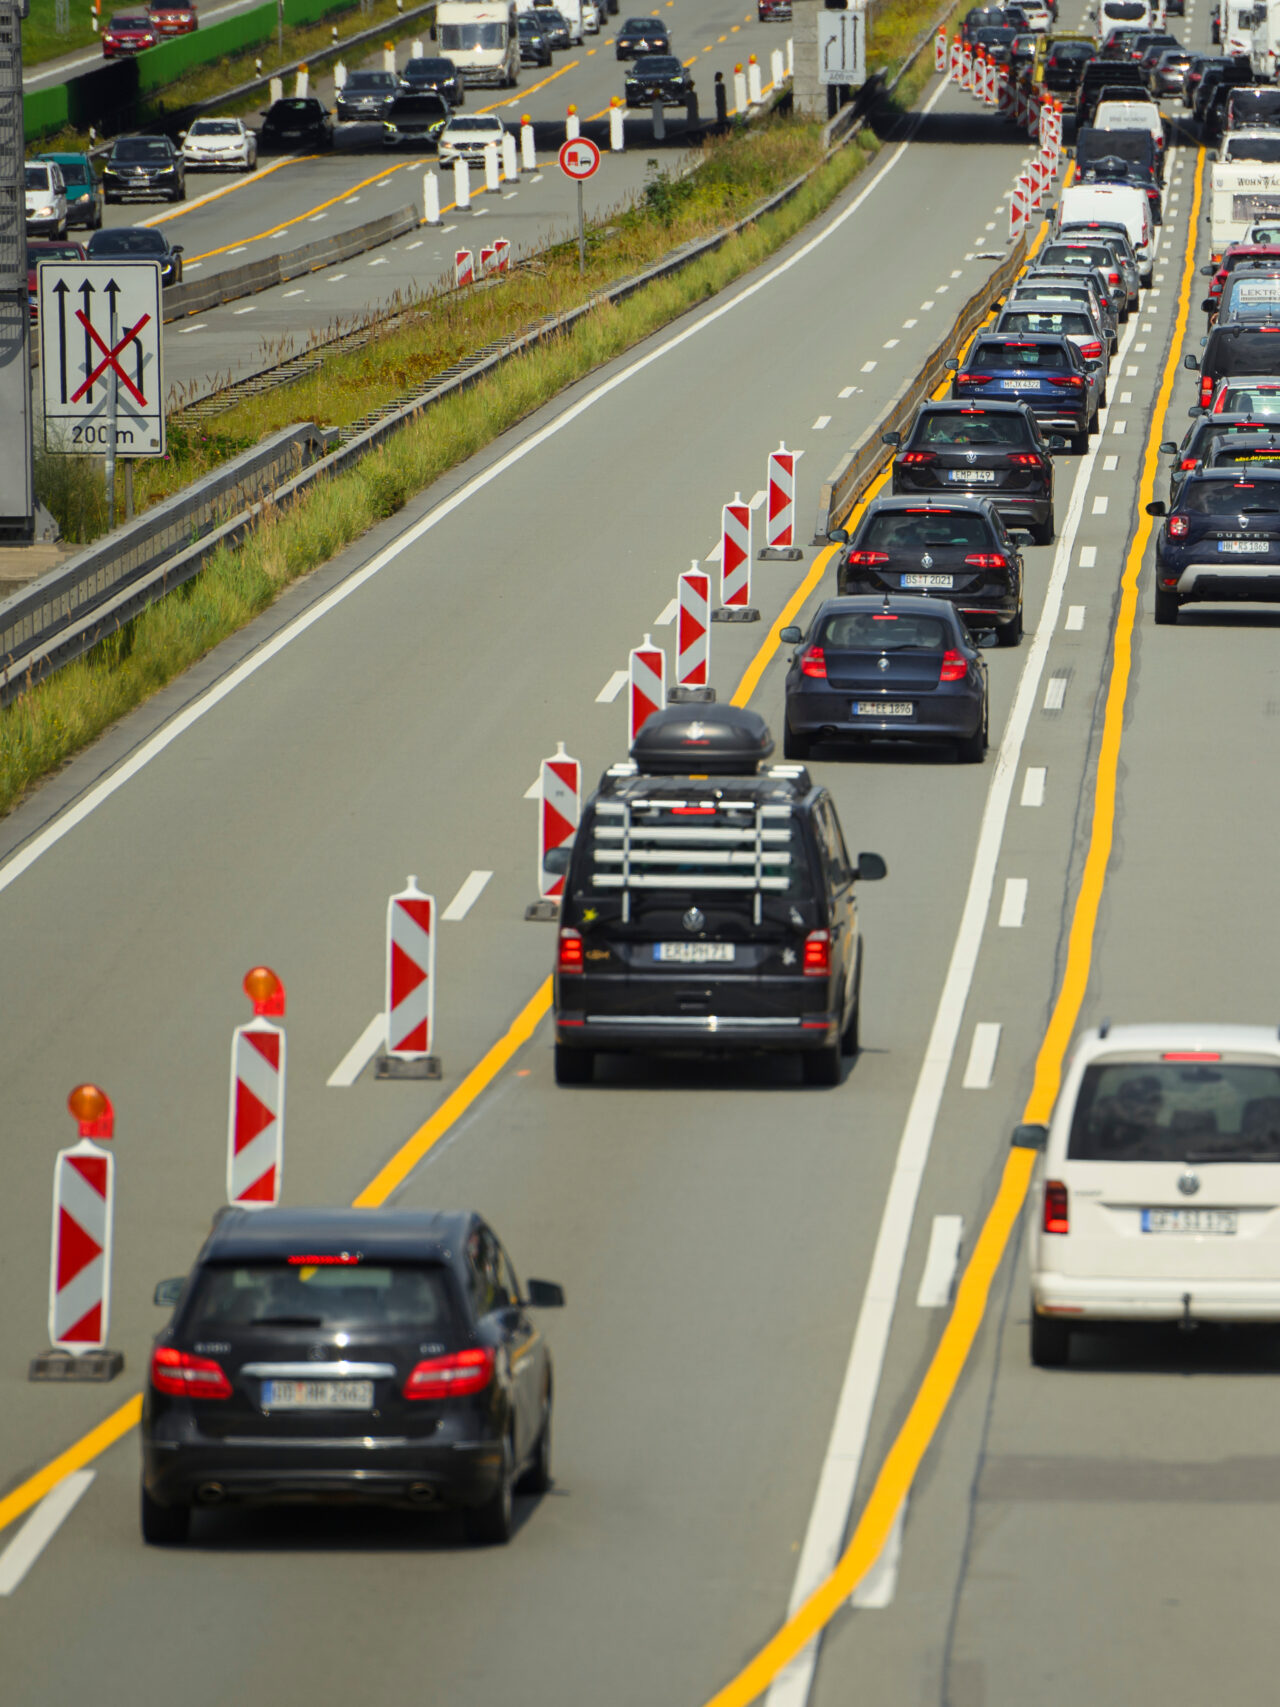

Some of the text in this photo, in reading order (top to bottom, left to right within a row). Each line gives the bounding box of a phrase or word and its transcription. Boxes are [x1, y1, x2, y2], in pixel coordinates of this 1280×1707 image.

[72, 425, 134, 444] 200 m
[956, 471, 991, 479] EMP 149
[1223, 541, 1233, 550] HH
[922, 575, 929, 585] T
[930, 575, 952, 585] 2021
